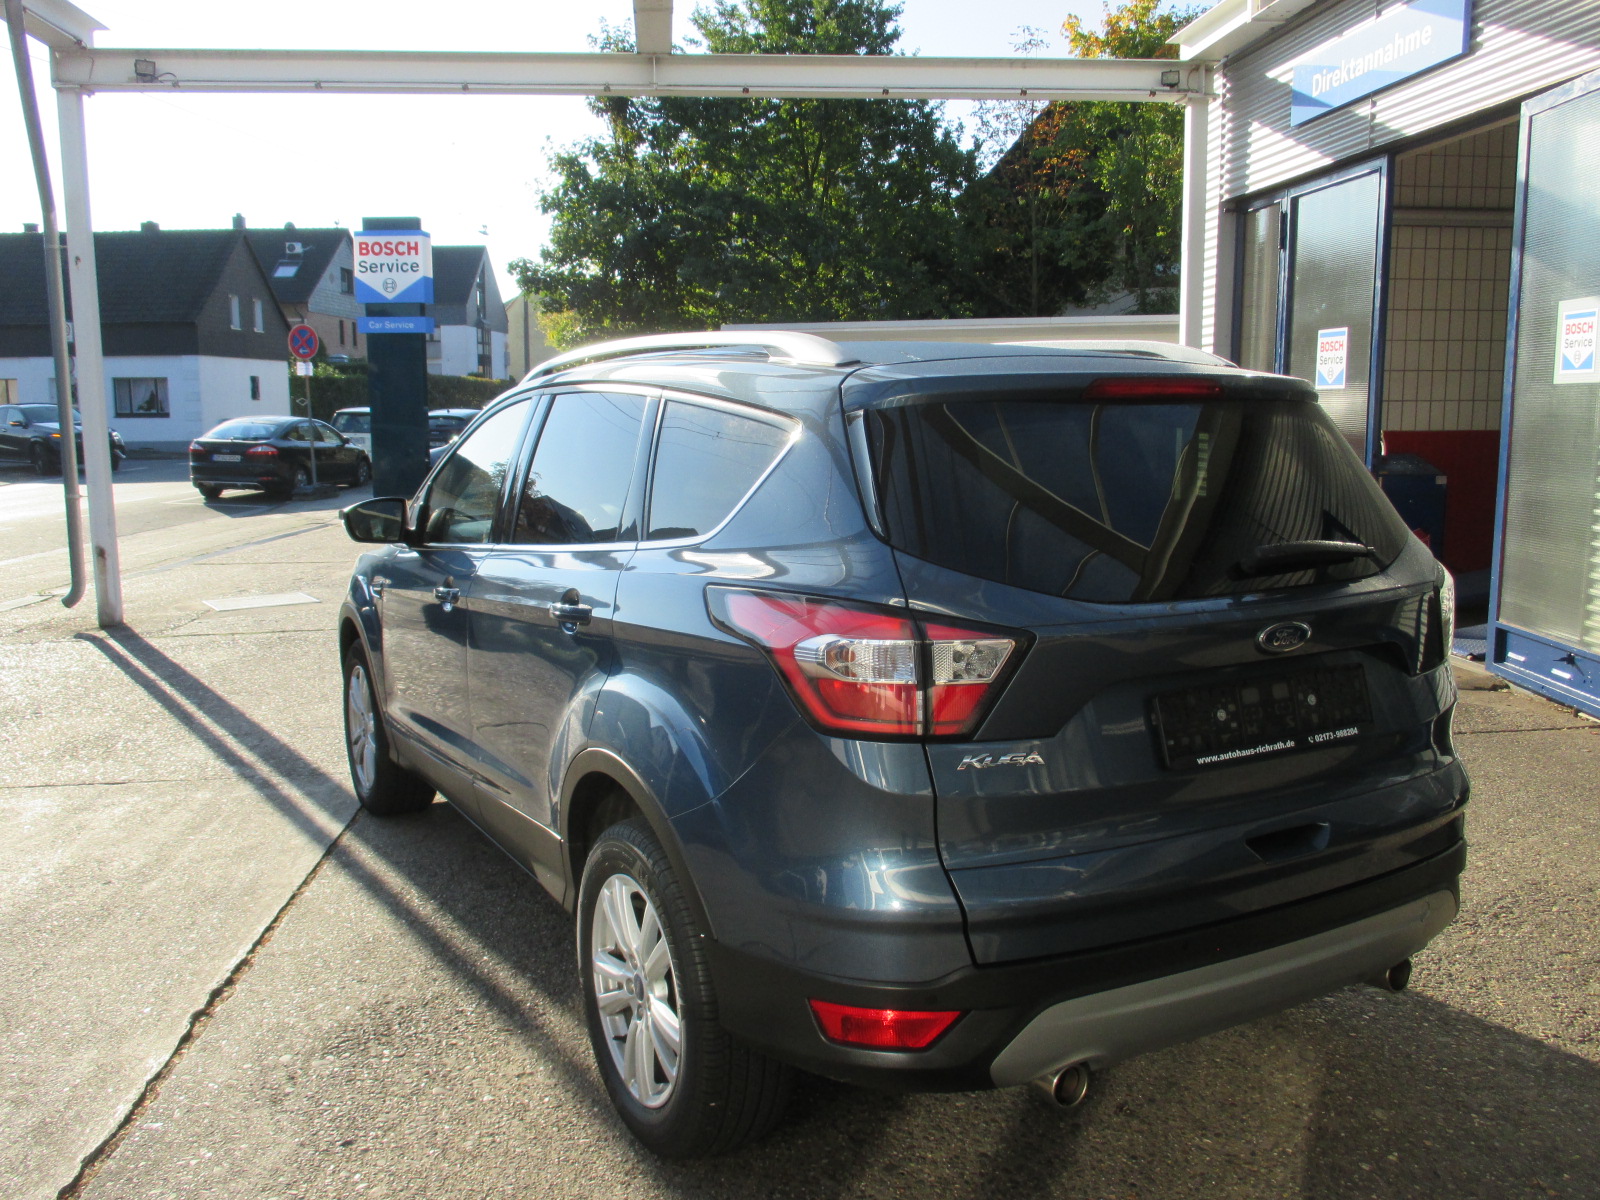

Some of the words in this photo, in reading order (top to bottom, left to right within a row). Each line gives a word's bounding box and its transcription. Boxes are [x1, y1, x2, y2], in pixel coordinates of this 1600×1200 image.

[1311, 24, 1433, 98] Direktannahme
[358, 241, 419, 256] BOSCH
[358, 258, 420, 273] Service
[368, 320, 382, 329] Car
[384, 320, 415, 329] Service
[1565, 321, 1594, 336] BOSCH
[1320, 340, 1344, 352] BOSCH
[1564, 336, 1593, 349] Service
[1319, 354, 1344, 365] Service
[1196, 739, 1296, 765] www.autohaus-richrath.de
[956, 751, 1045, 770] KUGA
